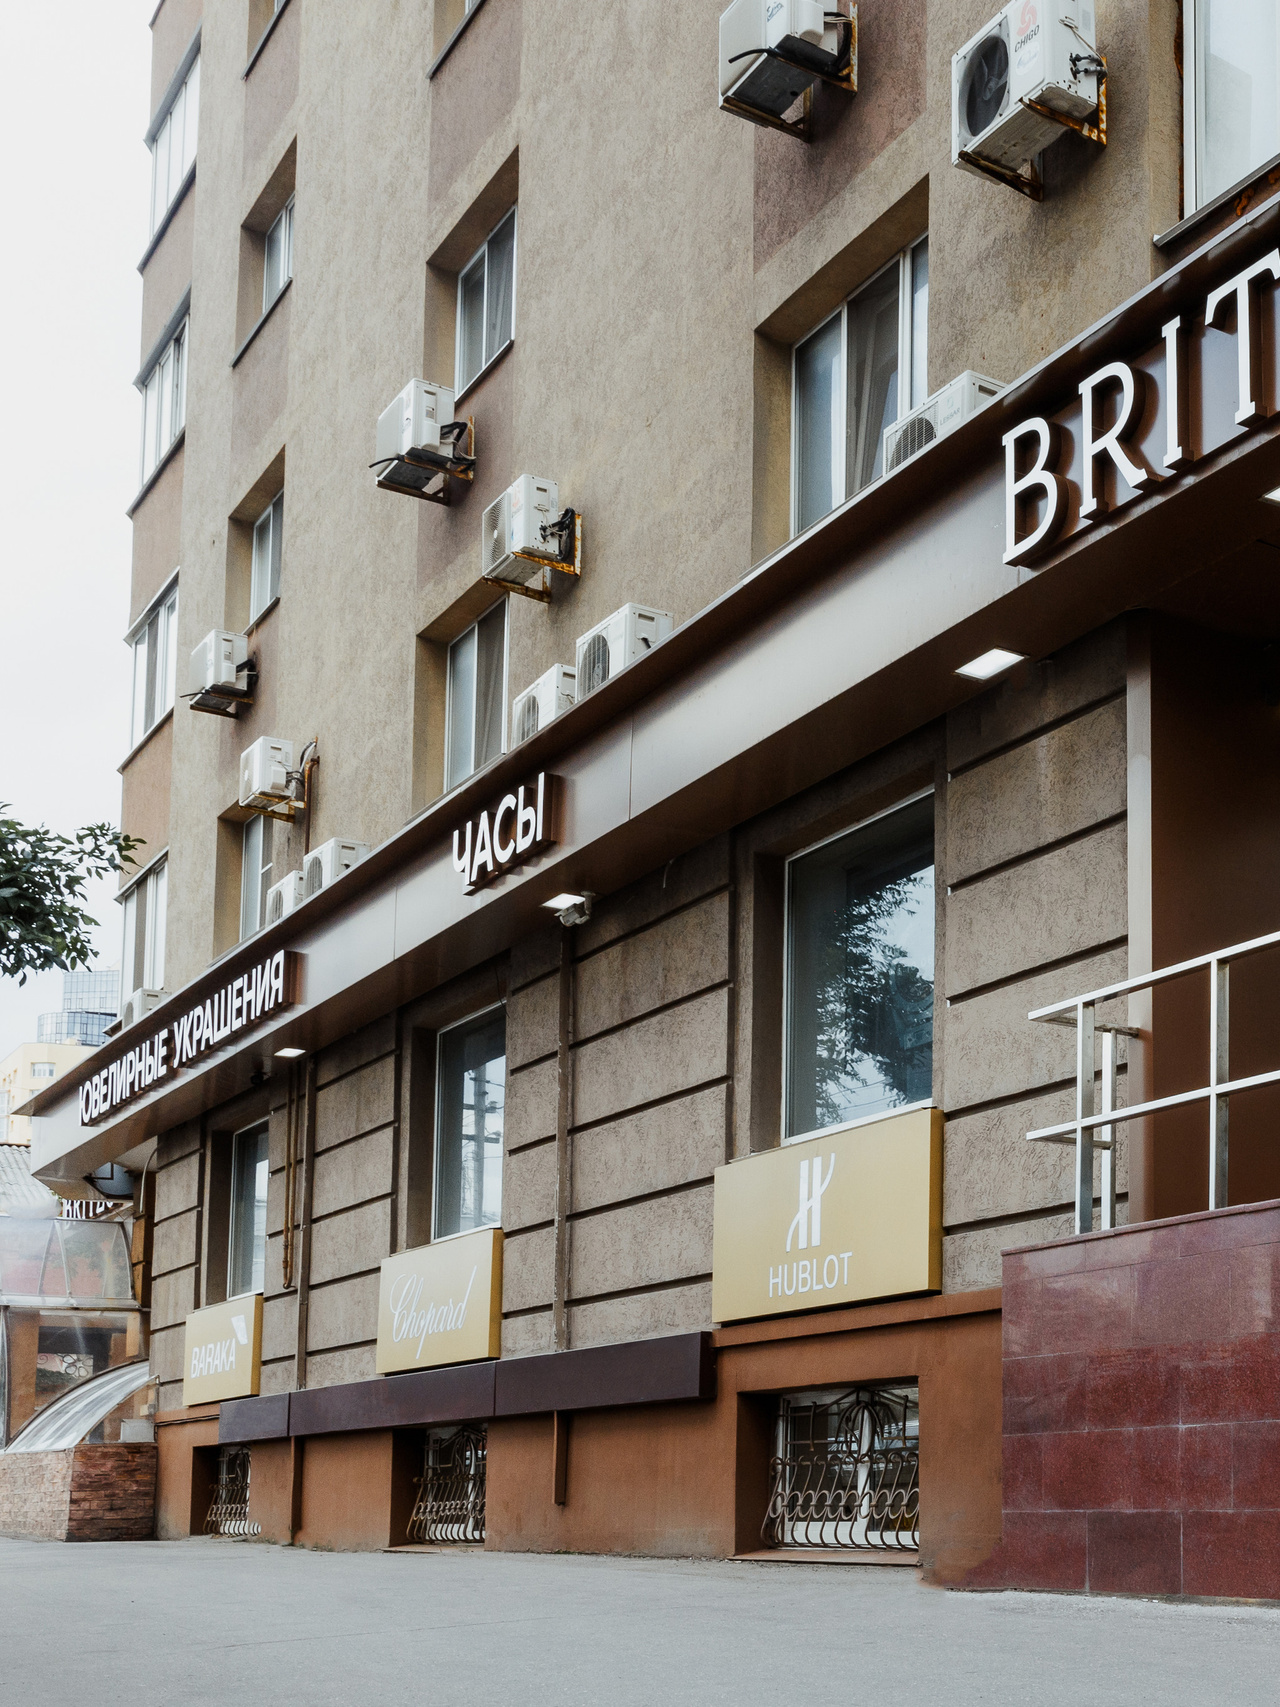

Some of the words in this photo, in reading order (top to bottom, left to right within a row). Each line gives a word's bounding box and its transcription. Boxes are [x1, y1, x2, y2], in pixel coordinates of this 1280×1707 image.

[1014, 24, 1040, 53] CHIGO
[453, 771, 545, 886] ЧАСЫ
[78, 1028, 168, 1126] ЮВЕЛИРНЫЕ
[173, 949, 285, 1068] УКРАШЕНИЯ
[62, 1200, 113, 1219] BRITZ
[769, 1251, 853, 1298] HUBLOT
[390, 1265, 477, 1360] Chopard
[190, 1338, 236, 1379] BARAKA
